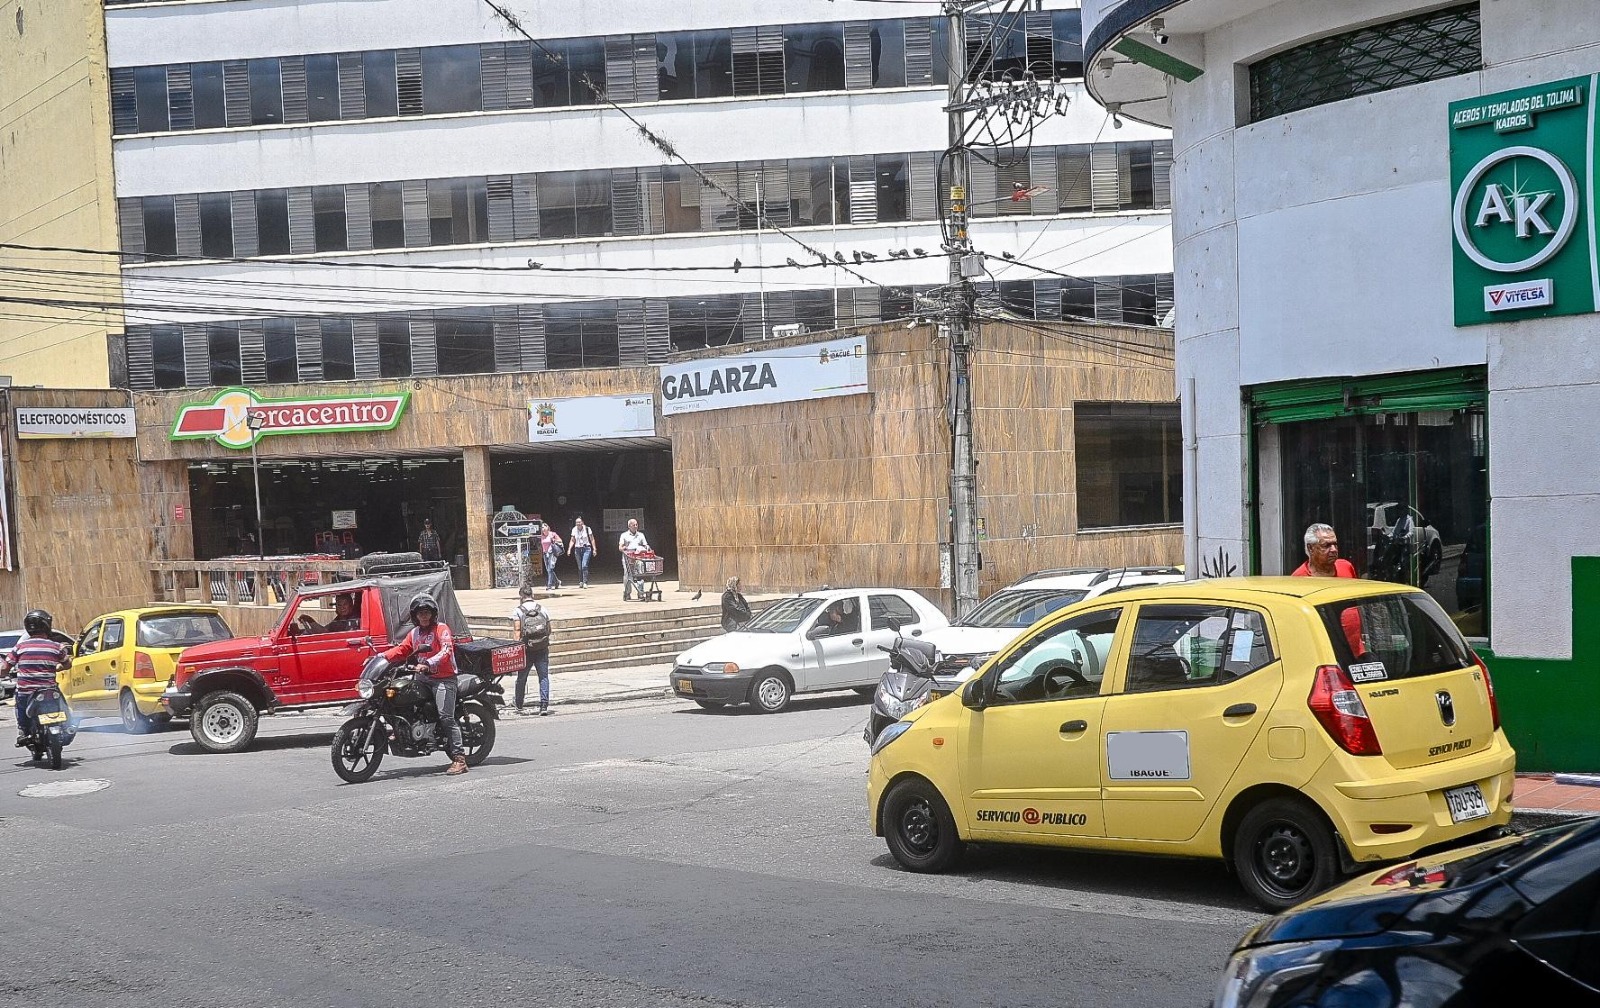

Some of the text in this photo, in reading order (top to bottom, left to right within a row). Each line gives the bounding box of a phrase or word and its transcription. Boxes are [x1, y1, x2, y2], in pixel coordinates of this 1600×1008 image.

[1453, 89, 1574, 125] ACEROS Y TEMPLADOS DEL TOLIMA
[1496, 114, 1527, 130] KAIROS
[1474, 183, 1556, 238] AK
[1505, 290, 1545, 303] VITELSA
[661, 363, 777, 401] GALARZA
[19, 410, 127, 425] ELECTRODOMÉSTICOS
[224, 402, 388, 432] Mercacentro
[1428, 738, 1472, 756] SERVICIO PUBLICO
[976, 809, 1021, 822] SERVICIO
[1041, 812, 1087, 825] PUBLICO
